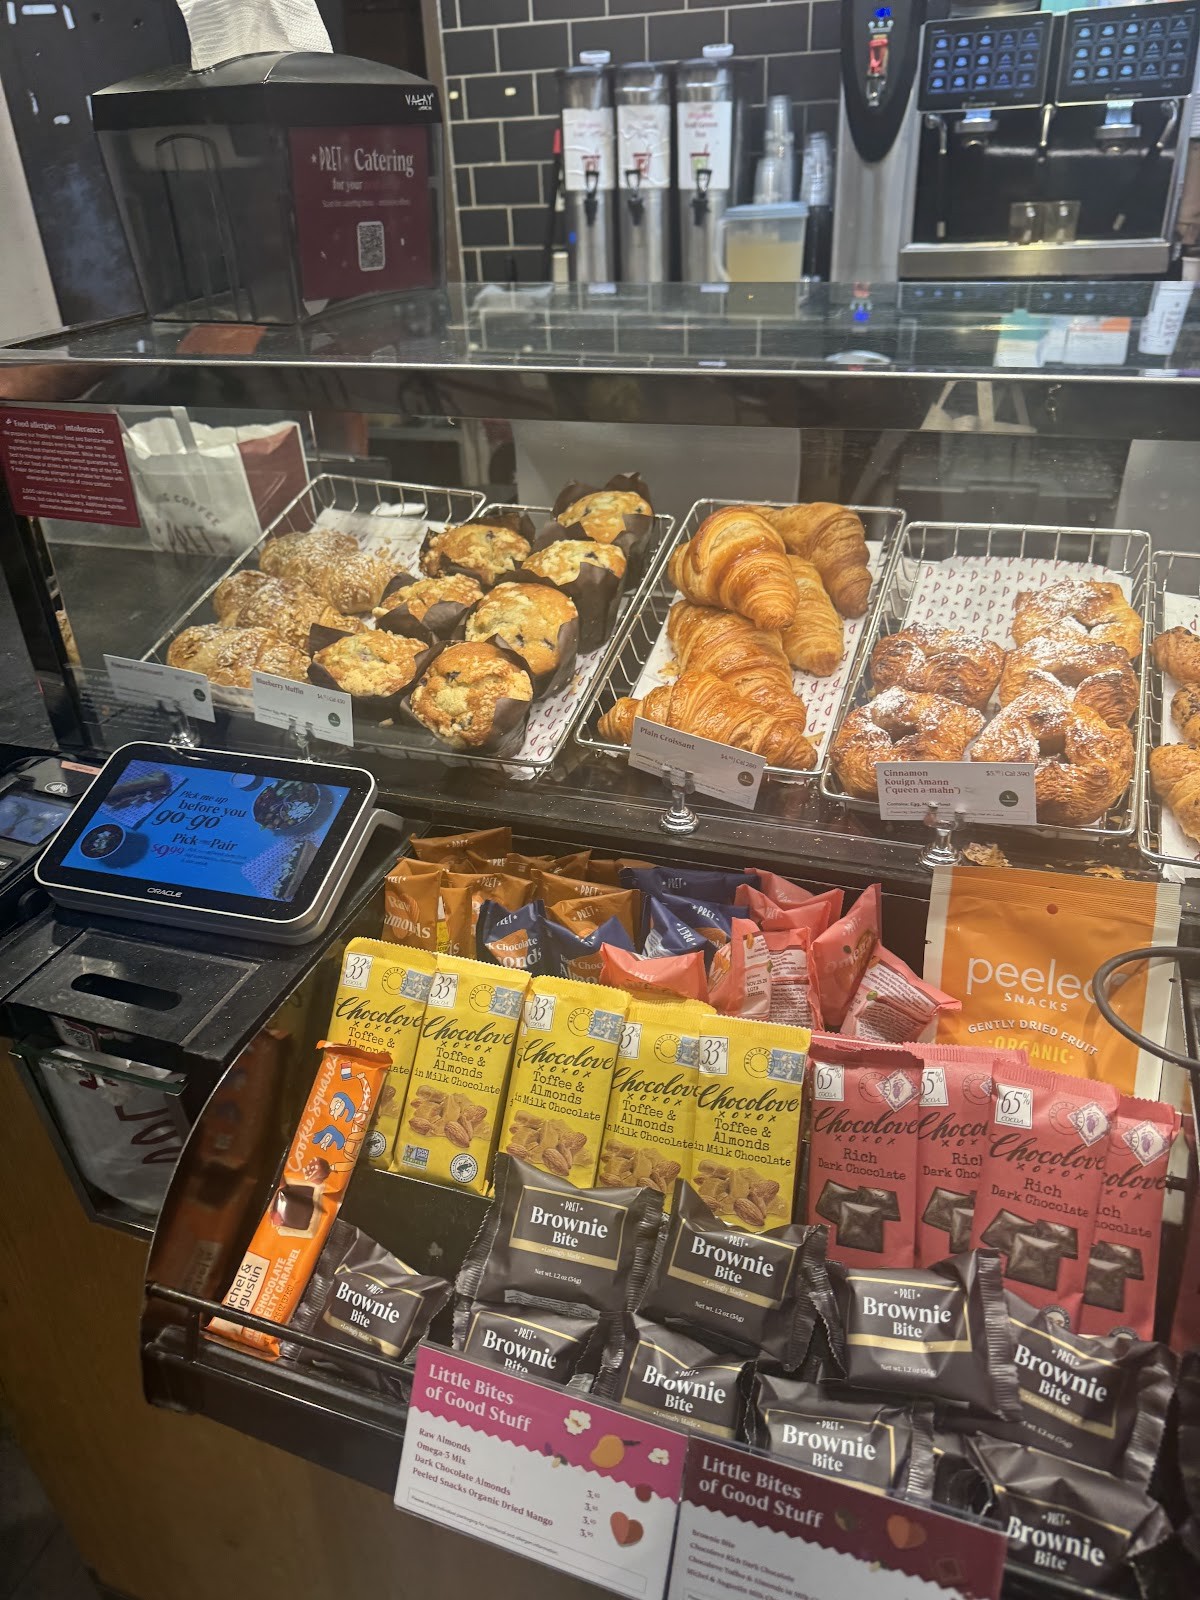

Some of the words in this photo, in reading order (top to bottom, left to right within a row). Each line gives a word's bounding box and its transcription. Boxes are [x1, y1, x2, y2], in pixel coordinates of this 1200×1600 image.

[319, 146, 342, 171] PRET
[354, 148, 414, 178] Catering
[346, 180, 363, 192] your
[256, 677, 284, 692] Blueberry
[285, 684, 304, 695] Muffin
[640, 727, 659, 739] Plain
[660, 733, 695, 750] Croissant
[883, 769, 928, 777] Cinnamon
[884, 778, 916, 787] Kouign
[917, 778, 949, 786] Amann
[179, 790, 199, 799] Pick
[215, 796, 229, 804] up
[179, 800, 220, 814] before
[220, 808, 248, 818] you
[151, 809, 221, 831] go-go
[172, 833, 199, 845] Pick
[209, 838, 238, 851] Pair
[452, 839, 468, 848] PRET
[147, 887, 183, 898] ORACLE
[480, 877, 498, 888] PRET
[580, 885, 599, 896] PRET
[667, 877, 683, 889] PRET
[387, 896, 411, 912] Raw
[577, 905, 595, 921] PRET
[697, 905, 715, 920] PRET
[496, 936, 538, 953] Chocolate
[677, 927, 694, 946] PRET
[336, 996, 421, 1028] Chocolove
[1004, 992, 1069, 1012] SNACKS
[349, 1026, 384, 1046] Toffee
[387, 1039, 396, 1048] &
[422, 1015, 514, 1045] Chocolove
[968, 1019, 1015, 1035] GENTLY
[1019, 1018, 1058, 1036] DRIED
[1060, 1031, 1098, 1055] FRUIT
[436, 1047, 475, 1066] Toffee
[477, 1058, 486, 1067] &
[518, 1038, 614, 1070] Chocolove
[994, 1035, 1070, 1064] ORGANIC
[433, 1059, 483, 1079] Almonds
[414, 1067, 424, 1077] in
[425, 1069, 449, 1085] Milk
[450, 1076, 500, 1096] Chocolate
[533, 1071, 572, 1090] Toffee
[575, 1083, 585, 1093] &
[530, 1085, 582, 1105] Almonds
[697, 1083, 800, 1113] Chocolove
[1001, 1090, 1030, 1114] 65%
[287, 1114, 316, 1173] Cookie
[310, 1054, 339, 1114] Squares
[514, 1092, 522, 1102] in
[522, 1095, 547, 1109] Milk
[548, 1101, 601, 1121] Chocolate
[714, 1117, 758, 1138] Toffee
[762, 1127, 772, 1138] &
[814, 1106, 918, 1135] Chocolove
[1001, 1115, 1024, 1124] COCOA
[713, 1131, 770, 1152] Almonds
[989, 1132, 1105, 1171] Chocolove
[693, 1140, 704, 1152] in
[706, 1143, 732, 1157] Milk
[734, 1149, 792, 1167] Chocolate
[843, 1148, 877, 1164] Rich
[818, 1157, 843, 1171] Dark
[846, 1163, 906, 1180] Chocolate
[923, 1165, 951, 1178] Dark
[1024, 1177, 1062, 1198] Rich
[564, 1201, 580, 1213] PRET
[991, 1184, 1021, 1201] Dark
[1025, 1194, 1089, 1218] Chocolate
[530, 1206, 608, 1239] Brownie
[552, 1231, 579, 1248] Bite
[728, 1235, 745, 1248] PRET
[691, 1236, 774, 1278] Brownie
[276, 1249, 302, 1293] CARAMEL
[714, 1264, 743, 1284] Bite
[226, 1275, 255, 1307] ichel
[241, 1264, 253, 1274] &
[256, 1257, 287, 1315] CHOCOLATE
[899, 1289, 916, 1300] PRET
[336, 1281, 400, 1324] Brownie
[694, 1301, 705, 1310] Net
[862, 1296, 952, 1324] Brownie
[350, 1309, 371, 1328] Bite
[518, 1326, 534, 1340] PRET
[893, 1321, 923, 1338] Bite
[482, 1329, 557, 1370] Brownie
[1057, 1348, 1075, 1366] PRET
[1013, 1343, 1108, 1402] Brownie
[428, 1363, 471, 1390] Little
[474, 1378, 514, 1405] Bites
[642, 1365, 726, 1404] Brownie
[1038, 1379, 1071, 1406] Bite
[425, 1384, 442, 1399] of
[444, 1391, 485, 1417] Good
[489, 1405, 533, 1433] Stuff
[664, 1394, 694, 1413] Bite
[821, 1420, 839, 1431] PRET
[418, 1427, 435, 1441] Raw
[436, 1433, 471, 1453] Almonds
[782, 1424, 876, 1461] Brownie
[416, 1440, 451, 1459] Omega-3
[451, 1452, 467, 1465] Mix
[812, 1452, 844, 1472] Bite
[414, 1453, 433, 1468] Dark
[434, 1460, 474, 1483] Chocolate
[475, 1475, 511, 1496] Almonds
[702, 1455, 751, 1484] Little
[755, 1471, 803, 1500] Bites
[412, 1467, 438, 1483] Peeled
[439, 1475, 467, 1494] Snacks
[468, 1488, 500, 1508] Organic
[501, 1498, 525, 1516] Dried
[526, 1508, 553, 1527] Mango
[699, 1477, 719, 1494] of
[721, 1483, 770, 1512] Good
[773, 1498, 824, 1529] Stuff
[1046, 1512, 1066, 1525] PRET
[692, 1529, 720, 1544] Brownie
[1006, 1515, 1106, 1566] Brownie
[726, 1554, 741, 1565] Rich
[742, 1560, 759, 1571] Dark
[760, 1565, 795, 1582] Chocolate
[1034, 1550, 1068, 1571] Bite
